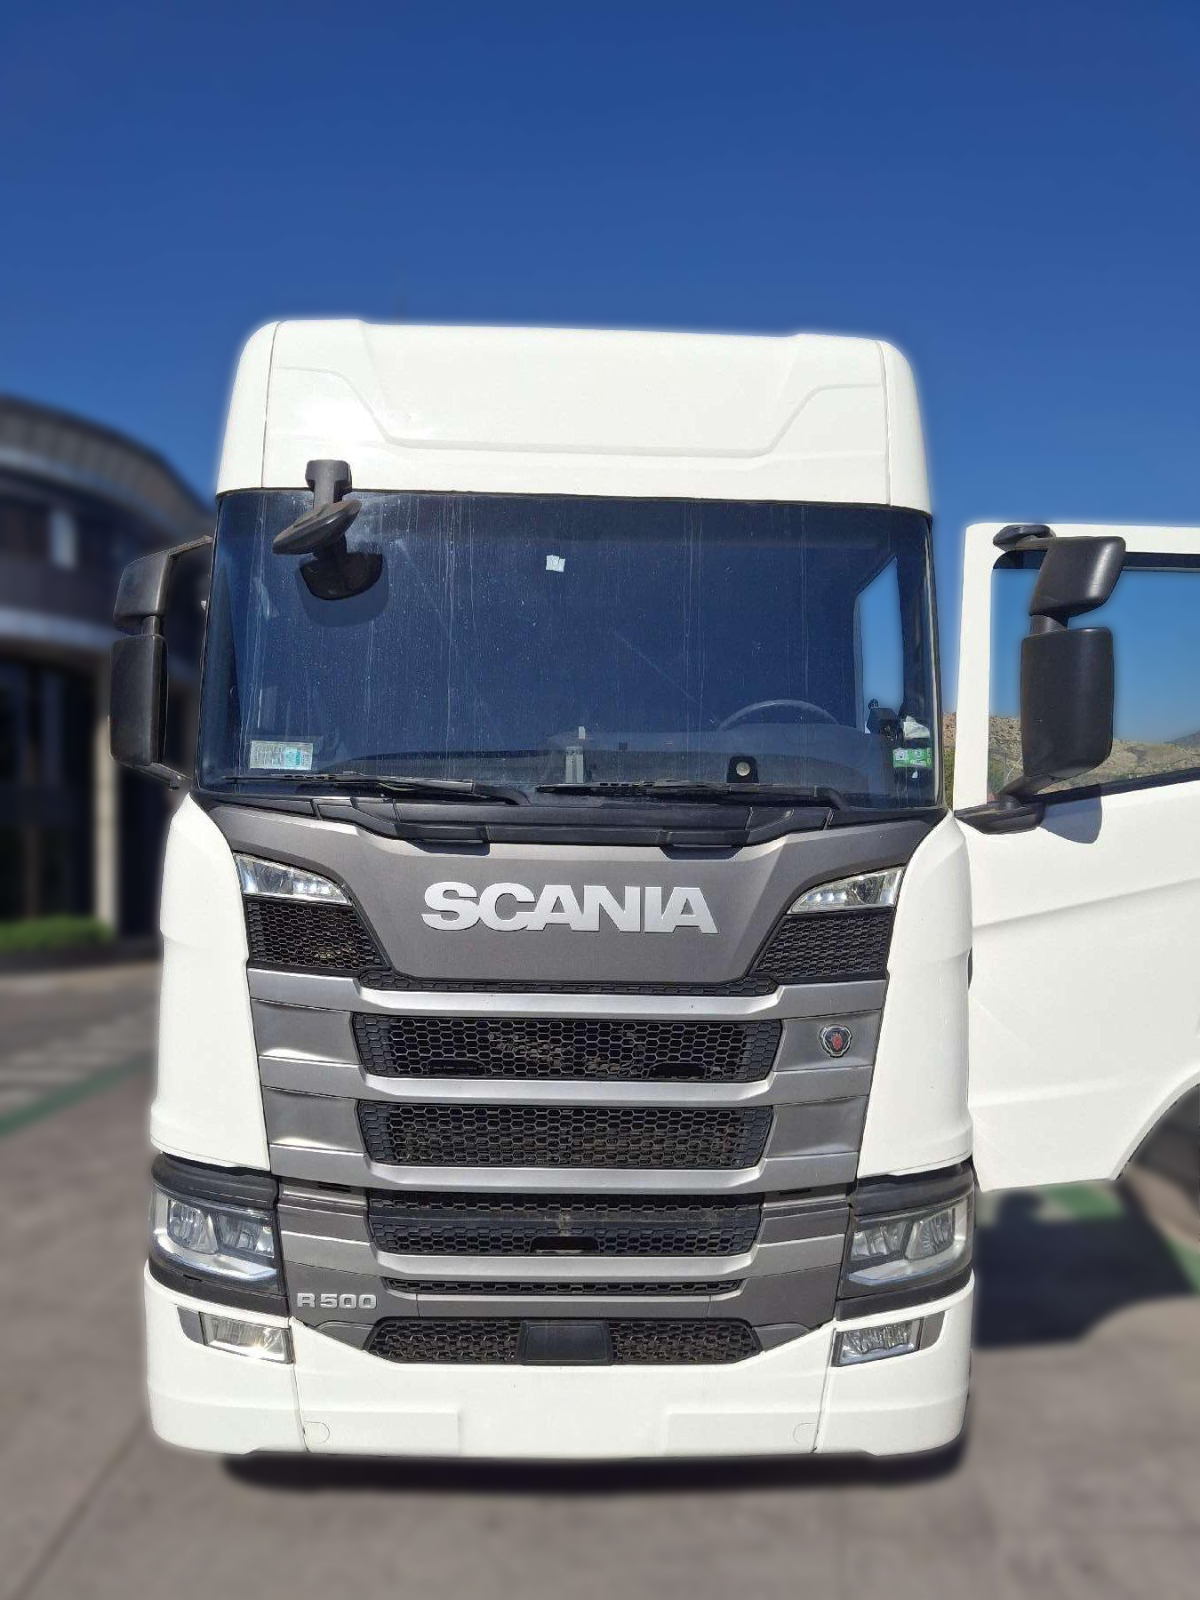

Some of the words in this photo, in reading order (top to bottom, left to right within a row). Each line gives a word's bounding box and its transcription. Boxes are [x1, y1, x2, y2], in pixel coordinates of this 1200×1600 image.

[421, 881, 719, 933] SCANIA
[297, 1292, 316, 1308] R
[320, 1293, 377, 1309] 500
